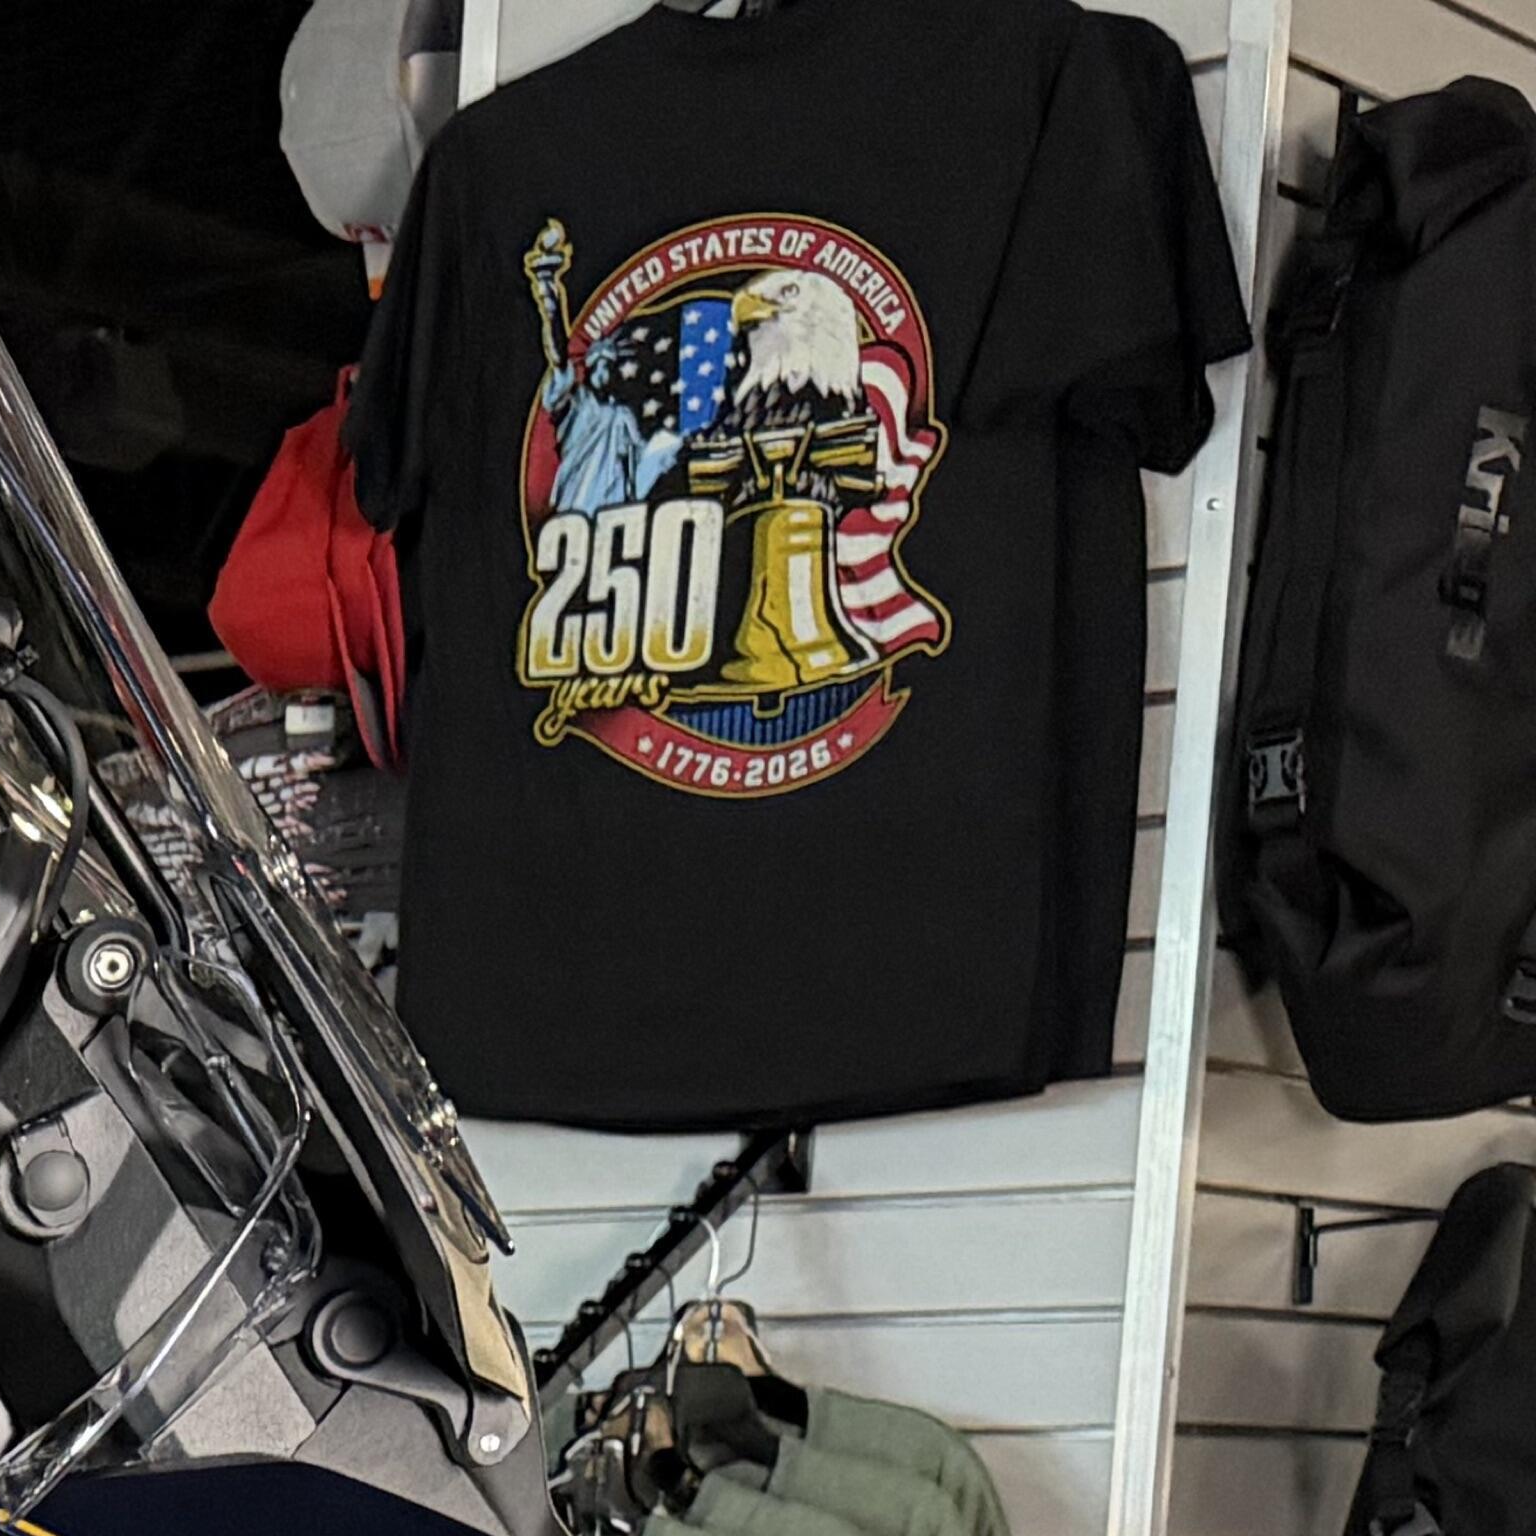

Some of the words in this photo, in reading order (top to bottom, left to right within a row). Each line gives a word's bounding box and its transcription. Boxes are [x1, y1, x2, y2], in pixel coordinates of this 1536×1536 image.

[583, 257, 664, 339] UNITED
[668, 228, 775, 272] STATES
[779, 228, 816, 258] OF
[814, 240, 907, 335] AMERICA
[529, 500, 724, 678] 250
[543, 674, 669, 735] years
